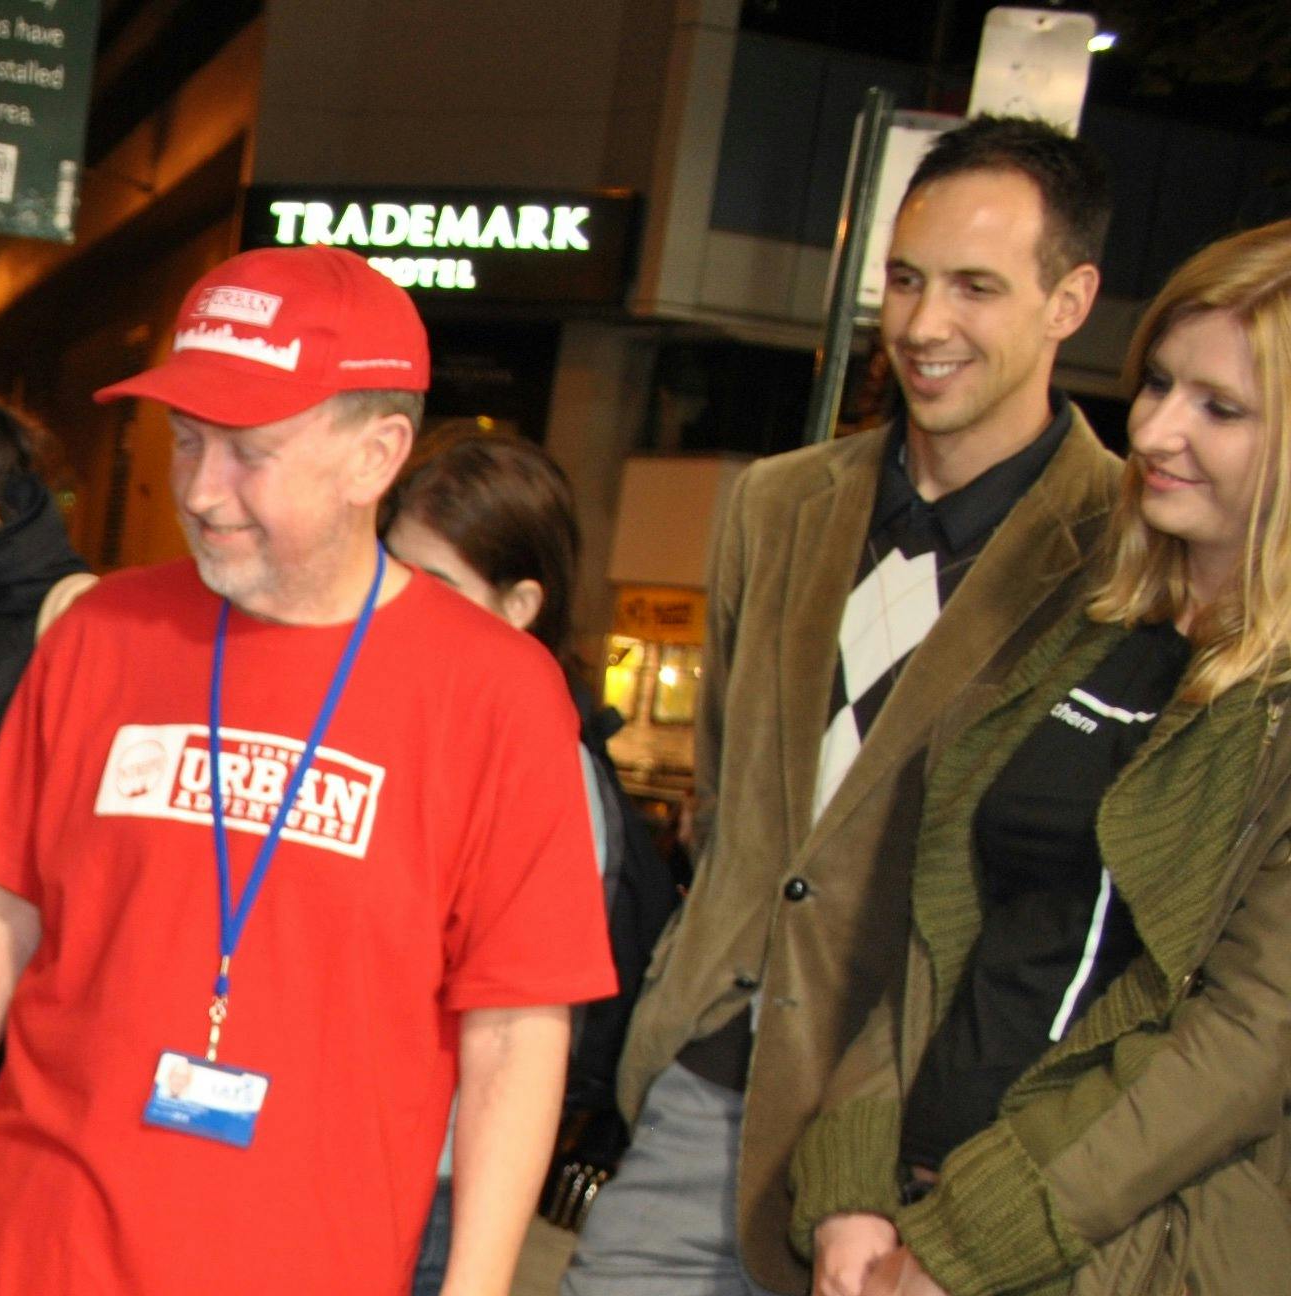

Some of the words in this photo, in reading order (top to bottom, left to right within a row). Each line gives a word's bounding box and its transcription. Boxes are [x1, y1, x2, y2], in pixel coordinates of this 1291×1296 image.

[13, 16, 65, 48] have
[269, 201, 590, 251] TRADEMARK
[181, 747, 368, 825] URBAN
